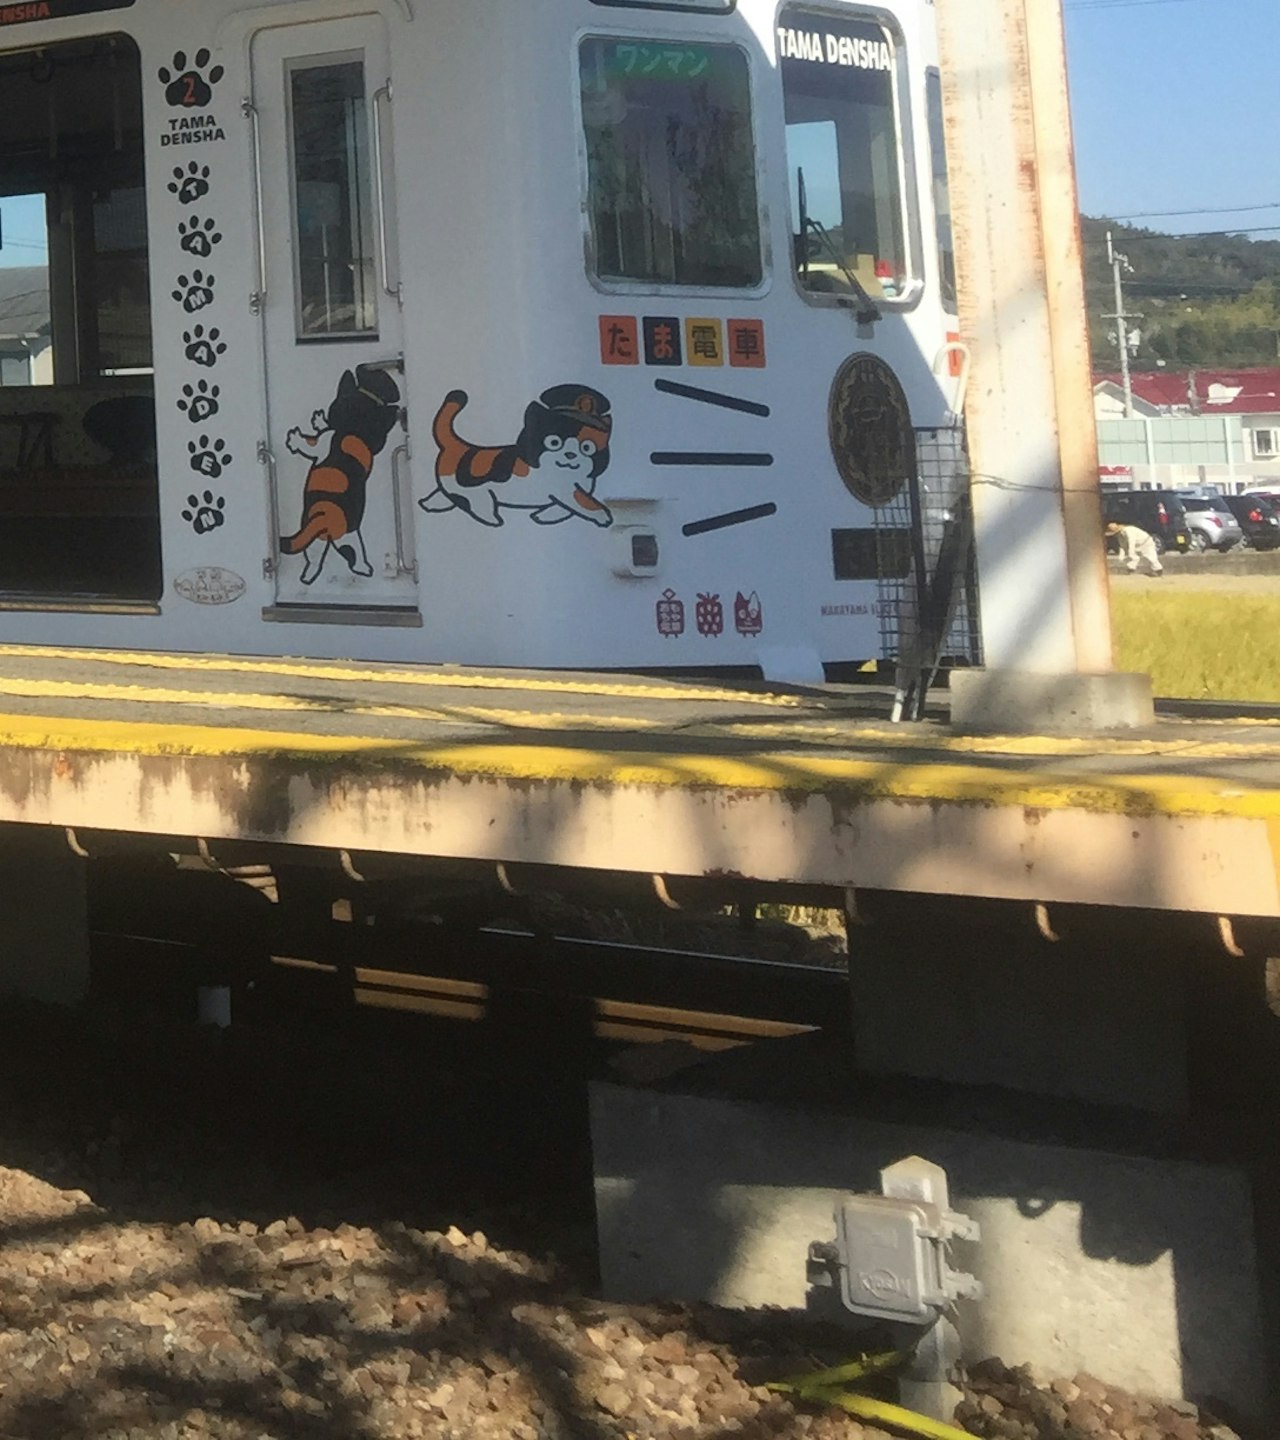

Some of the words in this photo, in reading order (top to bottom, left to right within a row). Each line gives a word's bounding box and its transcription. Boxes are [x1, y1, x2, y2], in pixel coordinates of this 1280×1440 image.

[616, 44, 708, 77] ワンマン
[777, 27, 824, 64] TAMA
[827, 33, 892, 71] DENSHA
[183, 77, 195, 103] 2
[160, 128, 226, 147] DENSHA
[169, 115, 216, 131] TAMA
[607, 322, 760, 360] たま電車
